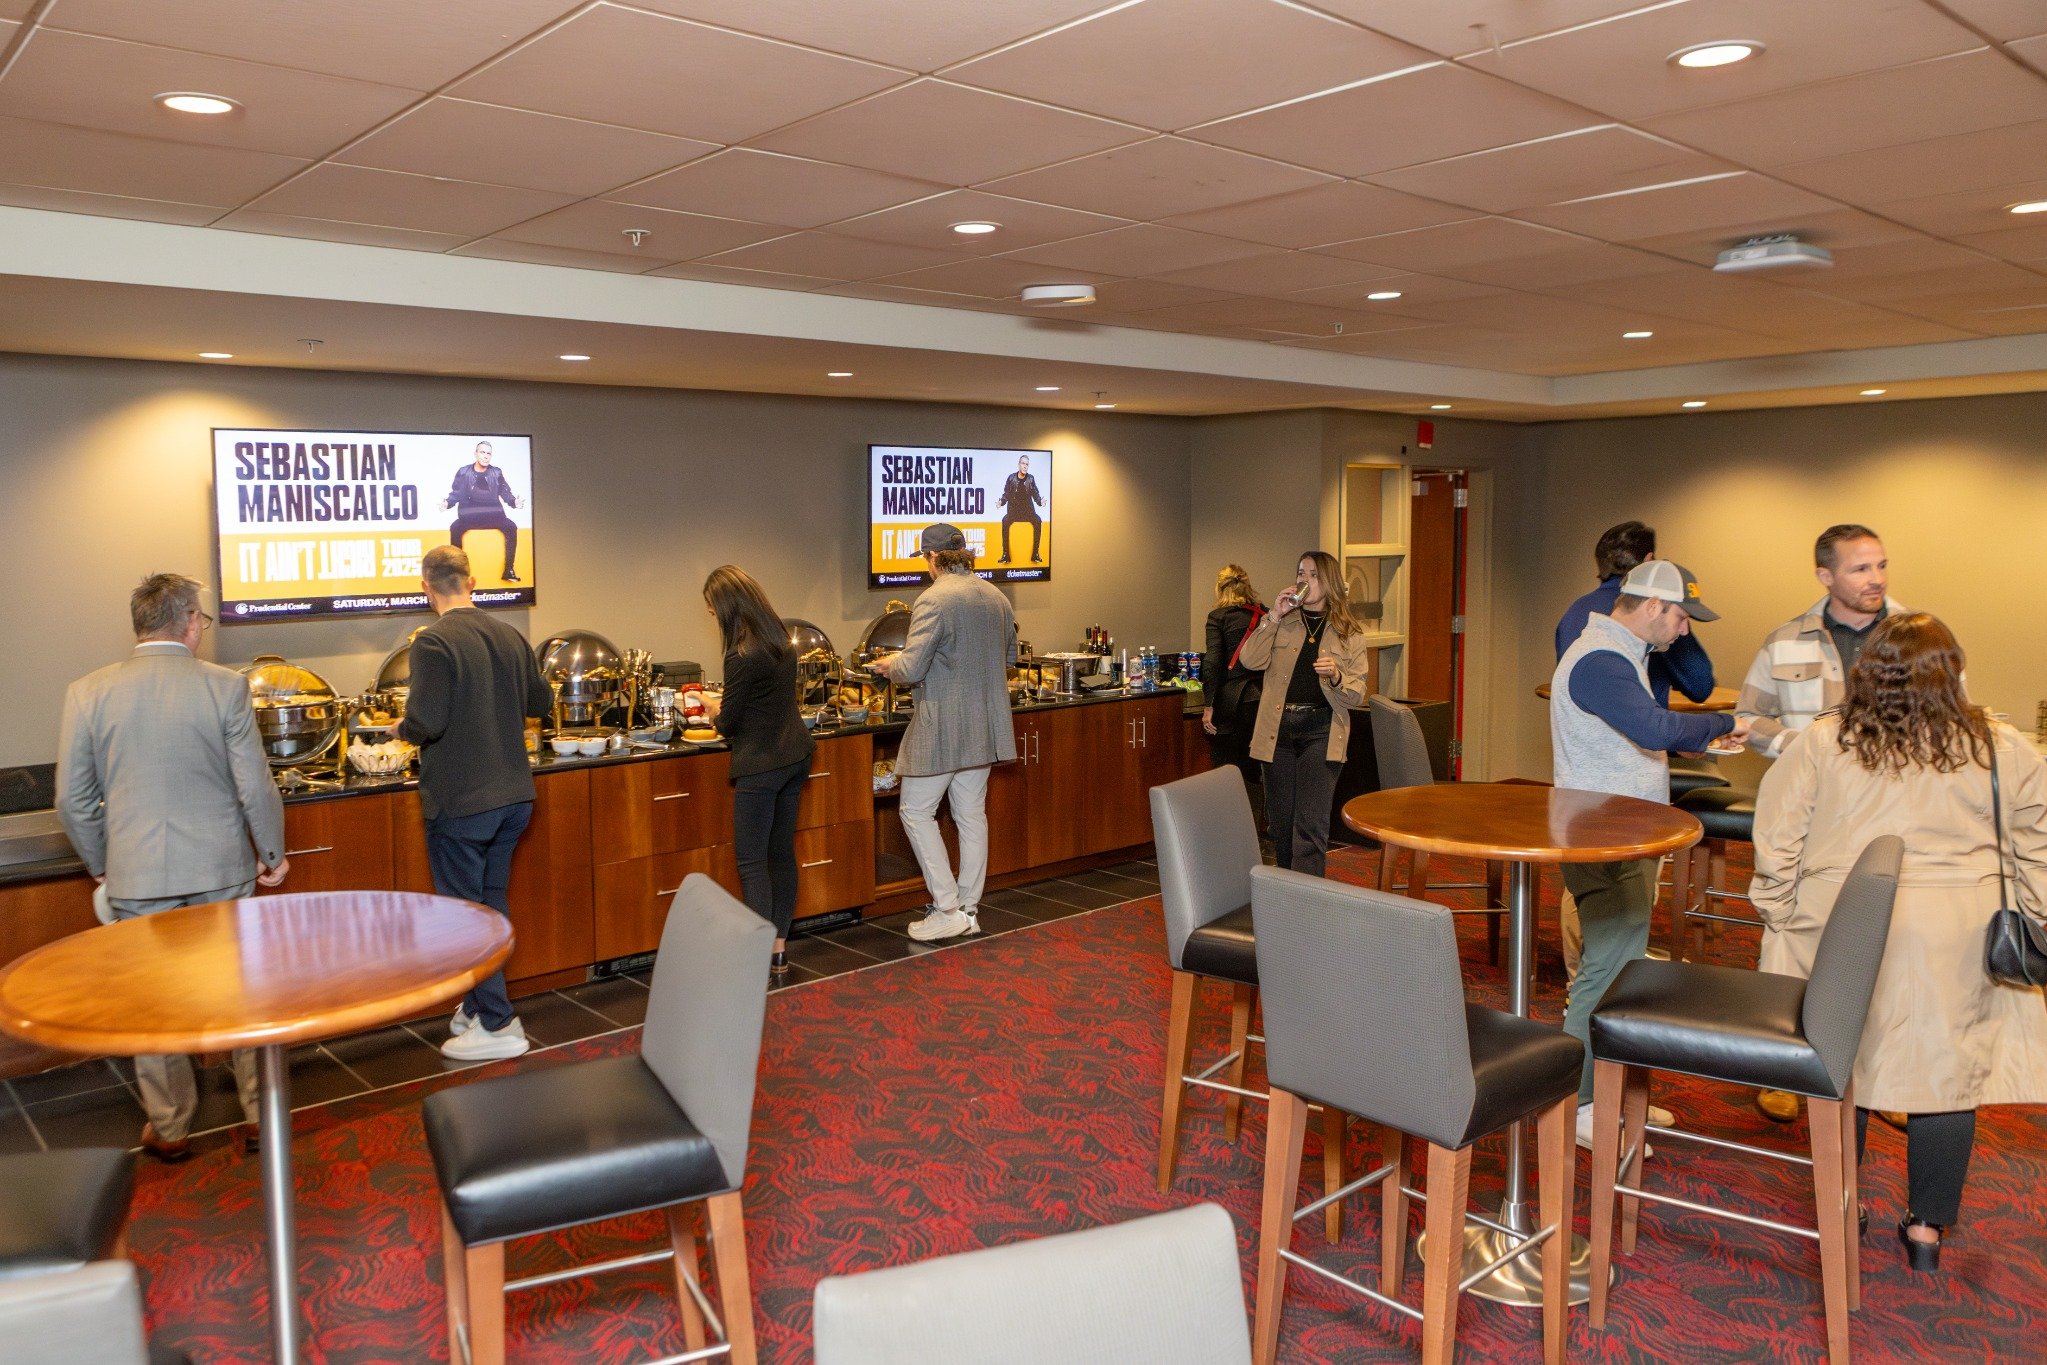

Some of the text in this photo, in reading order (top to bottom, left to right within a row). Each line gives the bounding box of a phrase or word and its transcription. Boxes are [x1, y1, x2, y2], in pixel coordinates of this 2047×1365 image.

[234, 441, 396, 481] SEBASTIAN
[882, 455, 973, 484] SEBASTIAN
[237, 484, 419, 523] MANISCALCO
[882, 486, 985, 515] MANISCALCO
[882, 529, 894, 559] IT
[238, 542, 260, 583] IT
[382, 557, 423, 578] 2025
[1006, 569, 1040, 578] ticketmaster
[249, 602, 312, 613] Prudential Center
[333, 596, 428, 609] SATURDAY, MARCH
